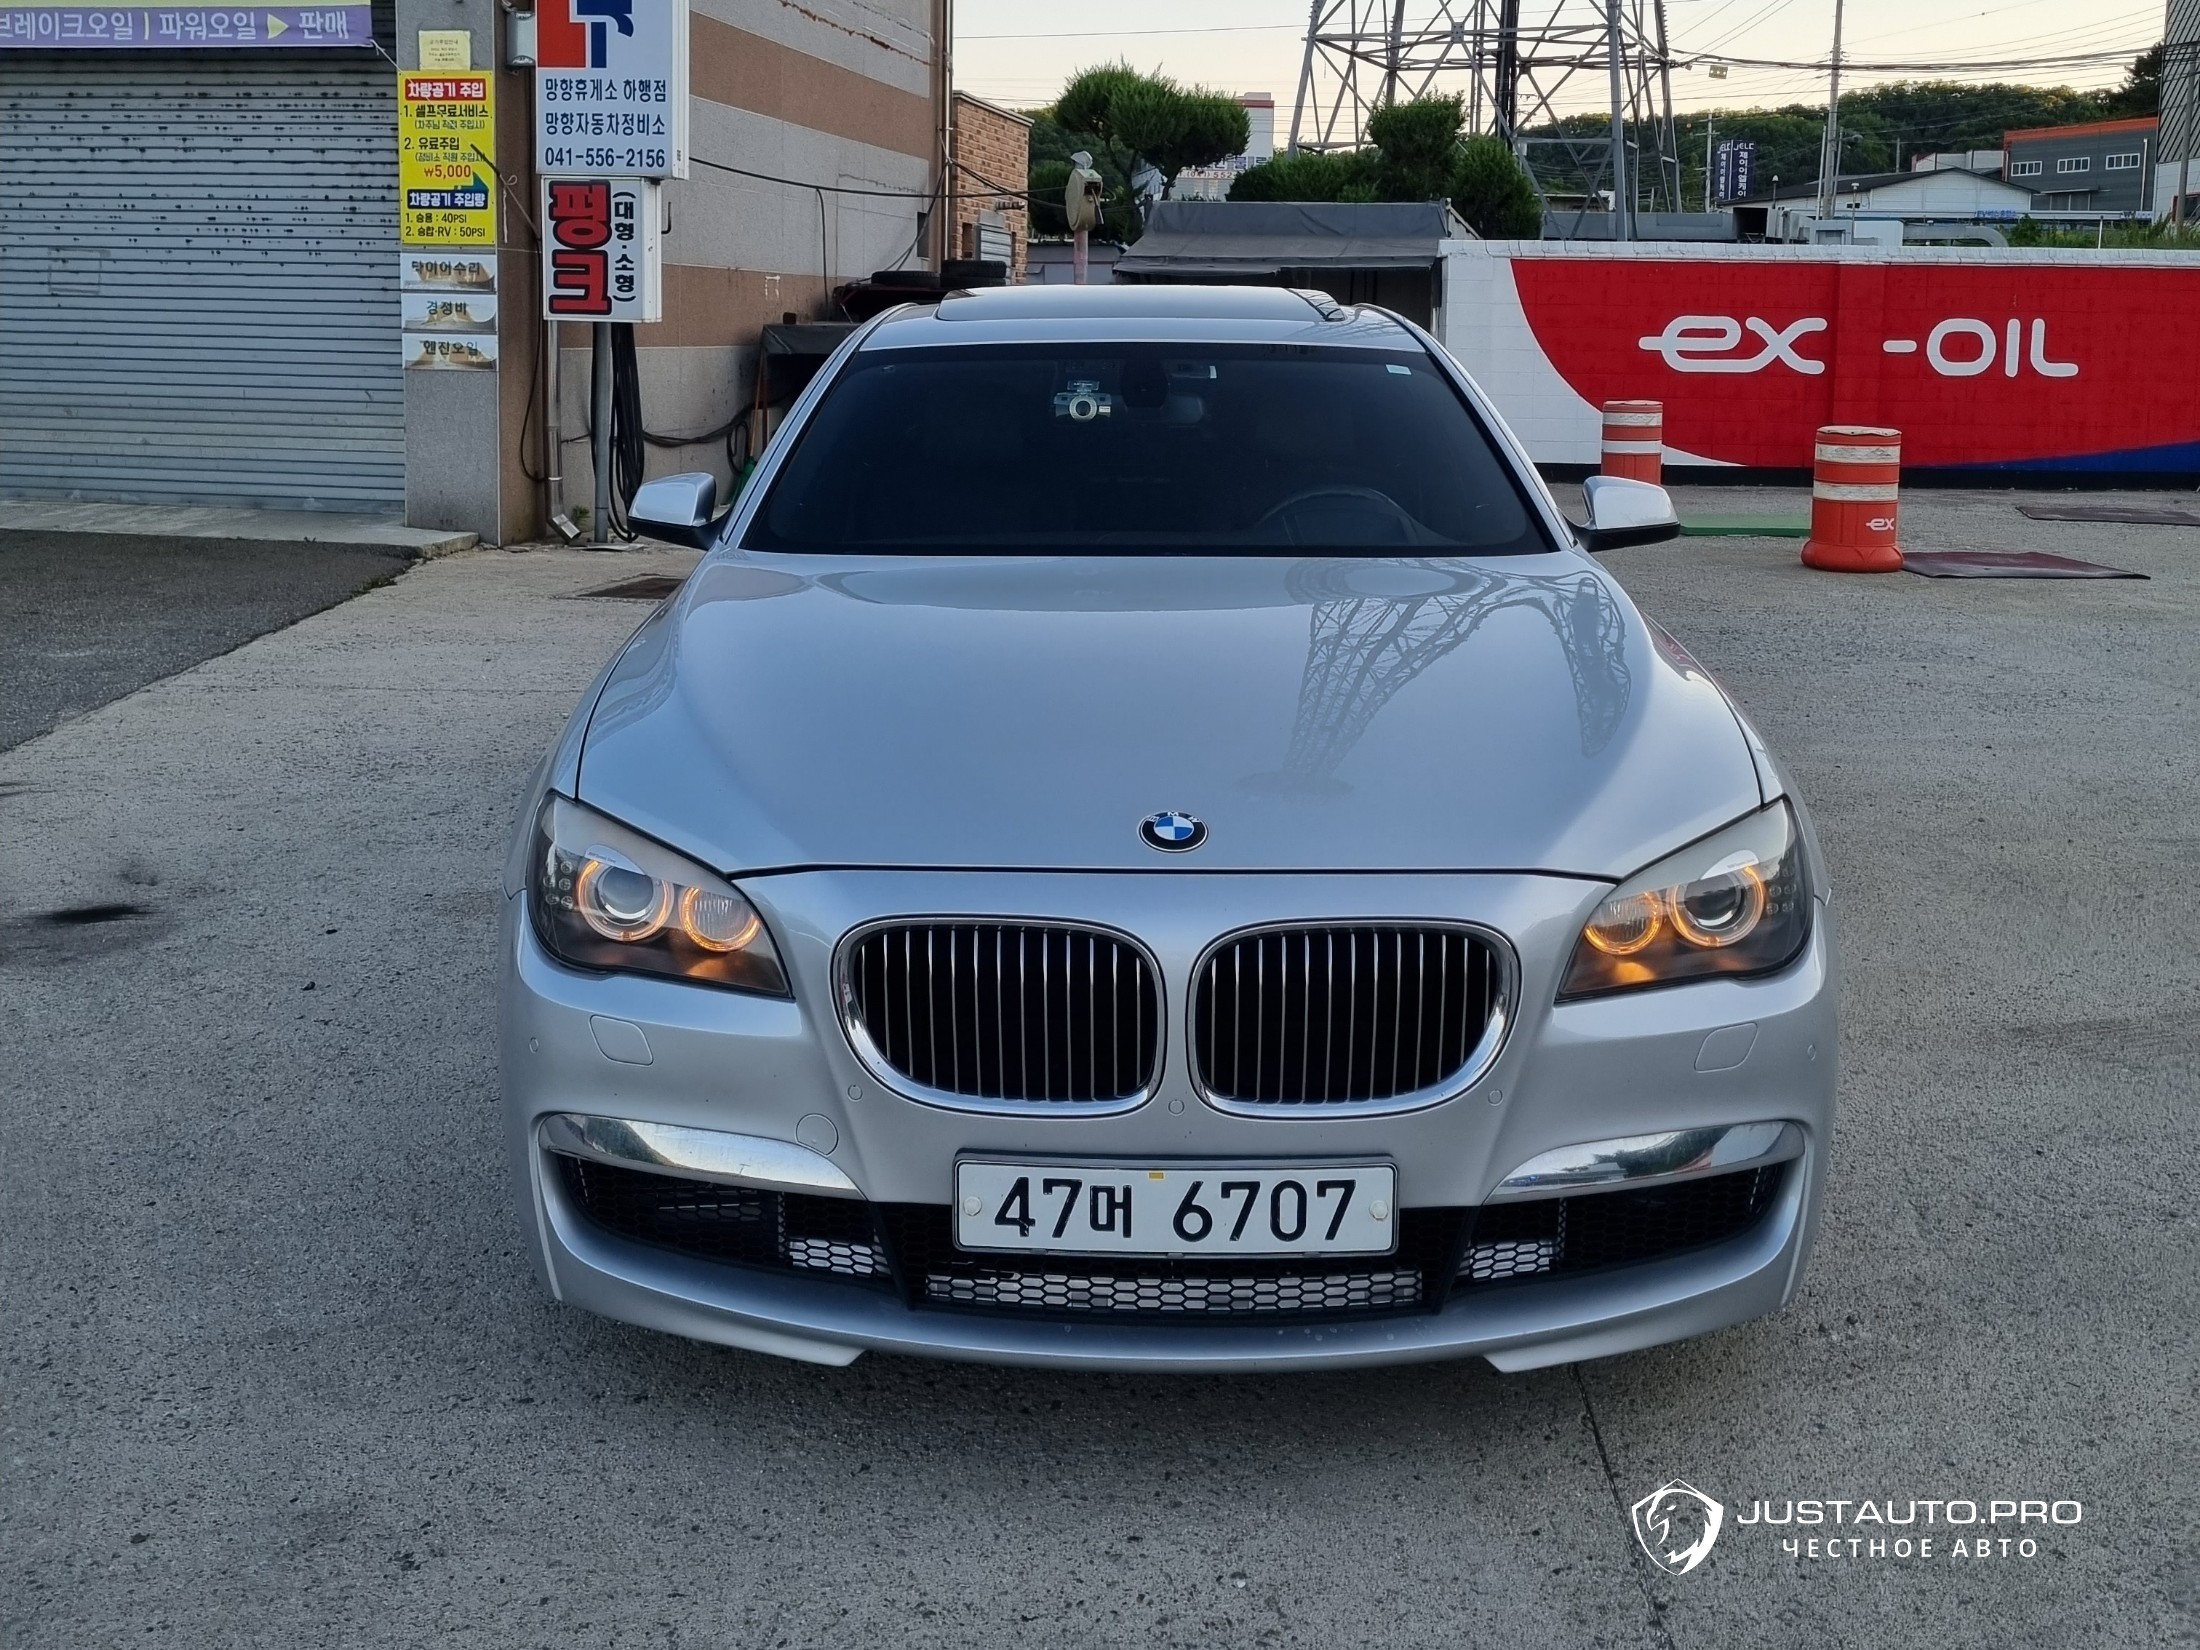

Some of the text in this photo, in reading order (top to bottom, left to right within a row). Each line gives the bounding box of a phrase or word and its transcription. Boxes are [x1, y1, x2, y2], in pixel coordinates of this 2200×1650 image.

[160, 11, 256, 40] 파워오일
[299, 10, 349, 39] 판매
[407, 82, 484, 98] 차량공기 주입
[545, 78, 666, 103] 망향휴게소 하행점
[403, 103, 489, 118] 1. 셀프무료서비스
[545, 112, 666, 137] 망향자동차정비소
[404, 136, 459, 151] 2. 유료주입
[544, 147, 666, 169] 041-556-2156
[409, 191, 486, 208] 차량공기 주입량
[405, 212, 414, 223] 1.
[415, 212, 433, 224] 승용
[441, 212, 467, 224] 40PSI
[405, 225, 415, 237] 2.
[459, 226, 486, 238] 50PSI
[548, 178, 613, 316] 펑크
[411, 260, 480, 276] 타이어수리
[426, 301, 468, 316] 경정비
[423, 340, 479, 356] 엔진오일
[994, 1176, 1357, 1243] 47머 6707
